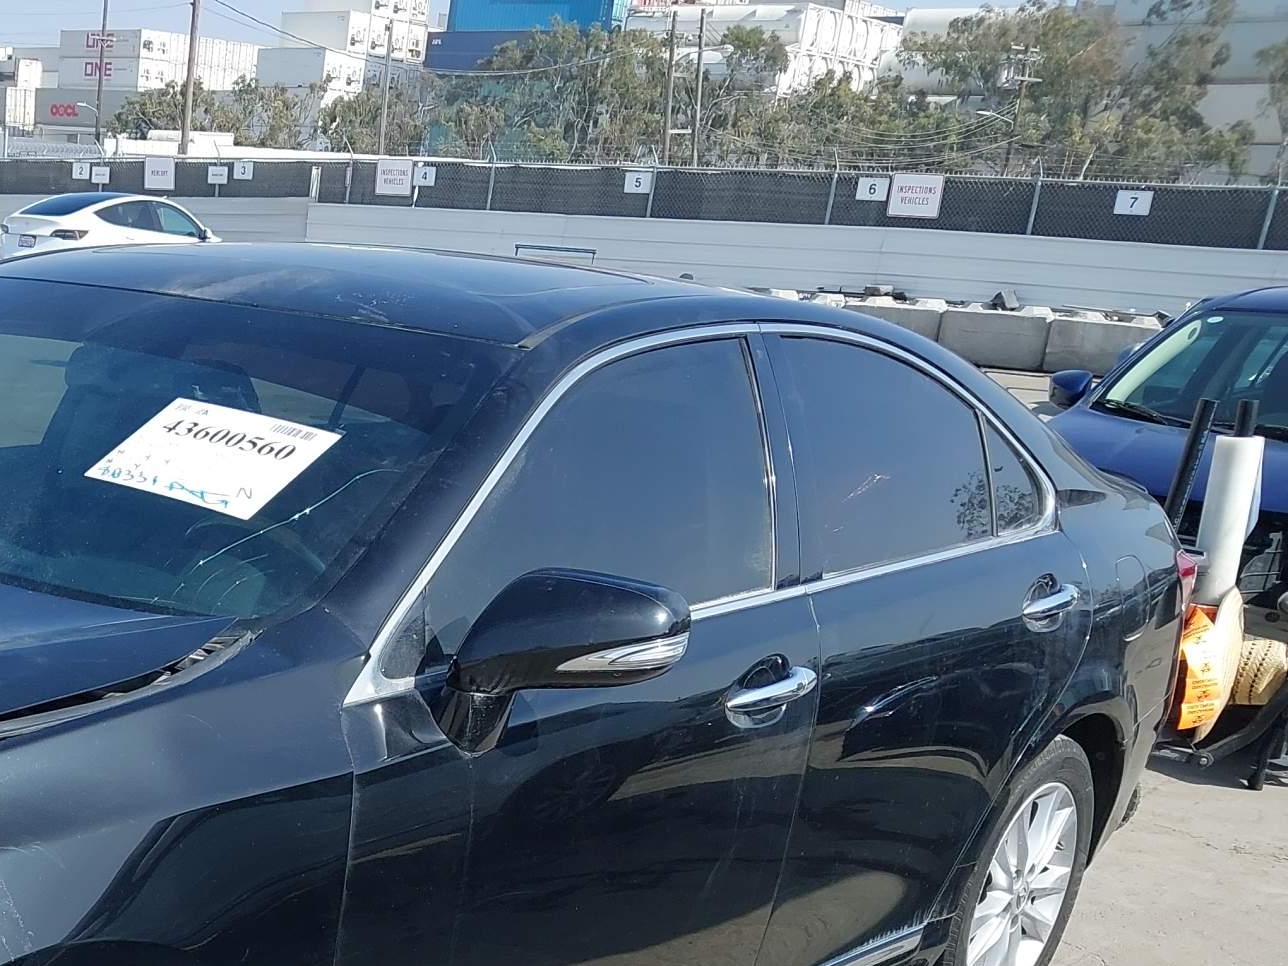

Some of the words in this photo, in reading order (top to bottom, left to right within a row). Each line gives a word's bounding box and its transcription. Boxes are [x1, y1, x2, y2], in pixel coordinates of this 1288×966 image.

[50, 104, 78, 117] OOCL
[78, 166, 84, 176] 2
[240, 165, 246, 175] 3
[381, 169, 408, 177] INSPECTIONS
[421, 171, 428, 181] 4
[634, 177, 642, 188] 5
[868, 183, 877, 195] 6
[897, 185, 937, 195] INSPECTIONS
[900, 197, 930, 206] VEHICLES
[1129, 196, 1139, 209] 7
[162, 419, 296, 461] 43600560
